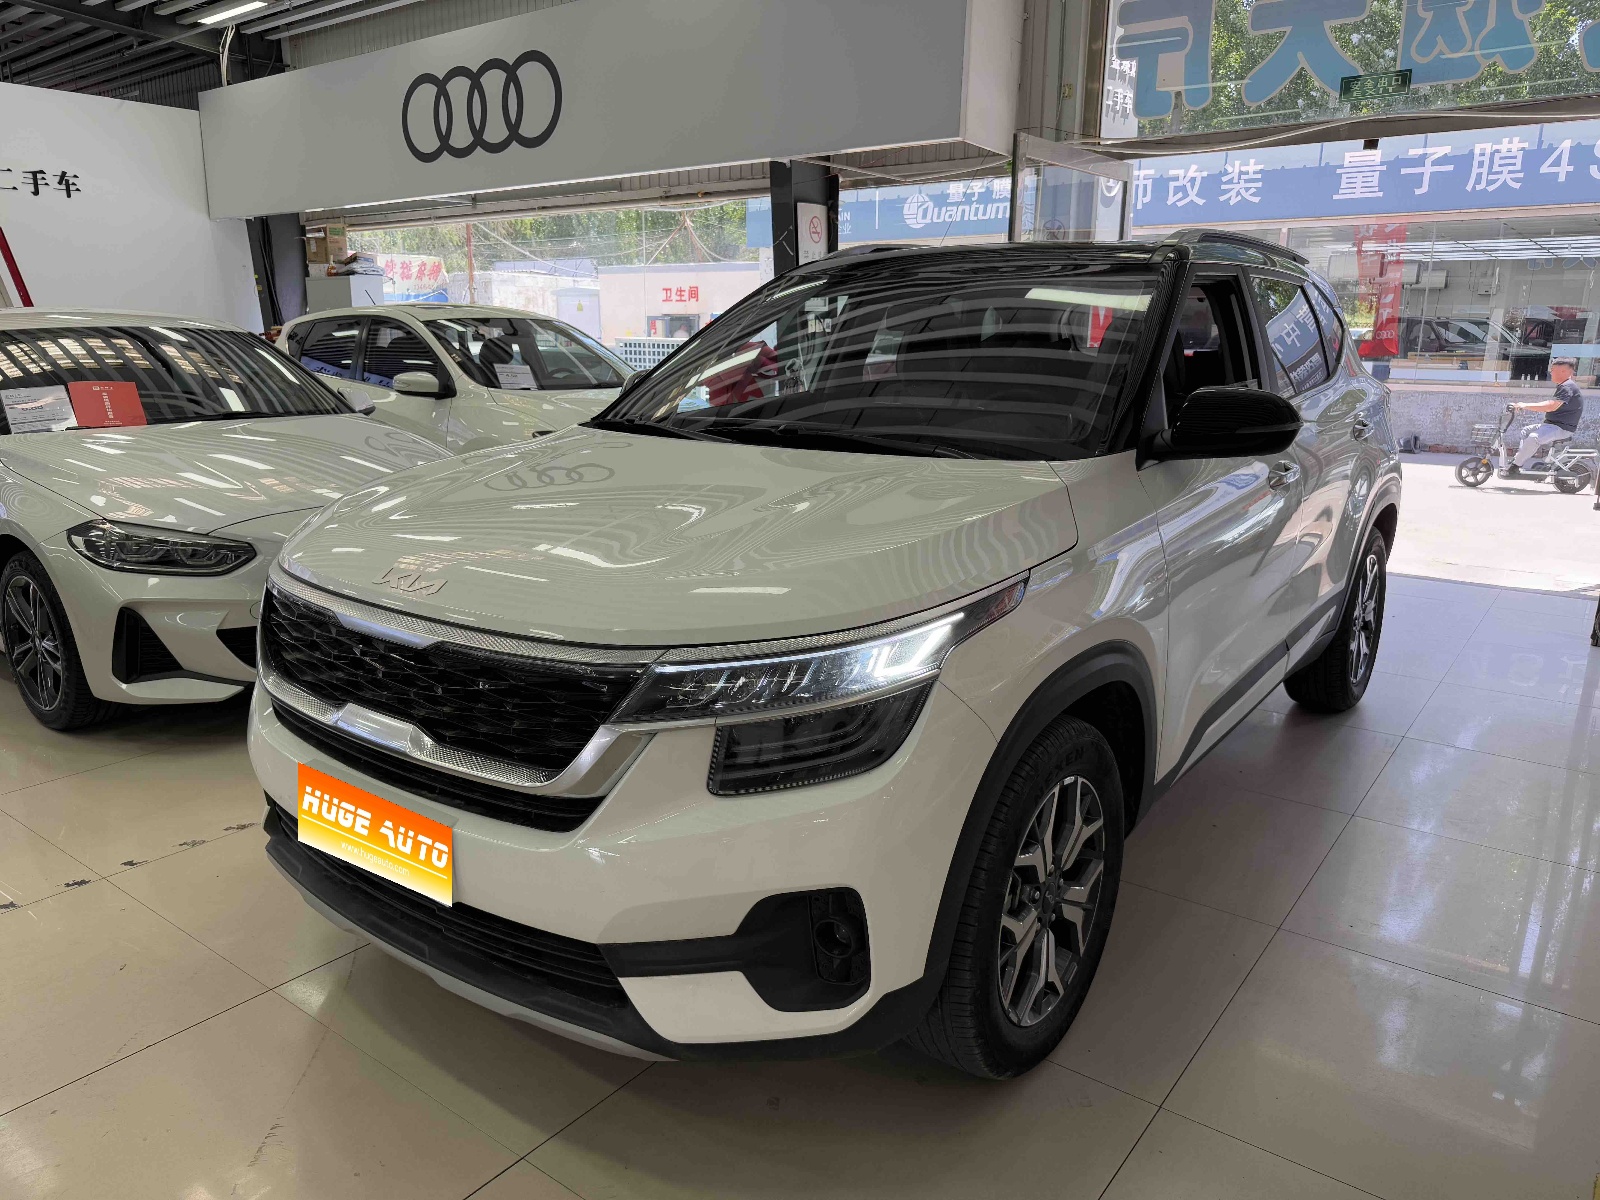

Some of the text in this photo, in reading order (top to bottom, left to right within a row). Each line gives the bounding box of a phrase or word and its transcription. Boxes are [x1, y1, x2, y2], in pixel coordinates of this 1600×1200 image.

[1350, 76, 1402, 91] 安全出口
[0, 167, 82, 199] 二手车
[947, 179, 1011, 203] 量子膜
[915, 200, 1010, 223] Quantum
[661, 286, 699, 302] 卫生间
